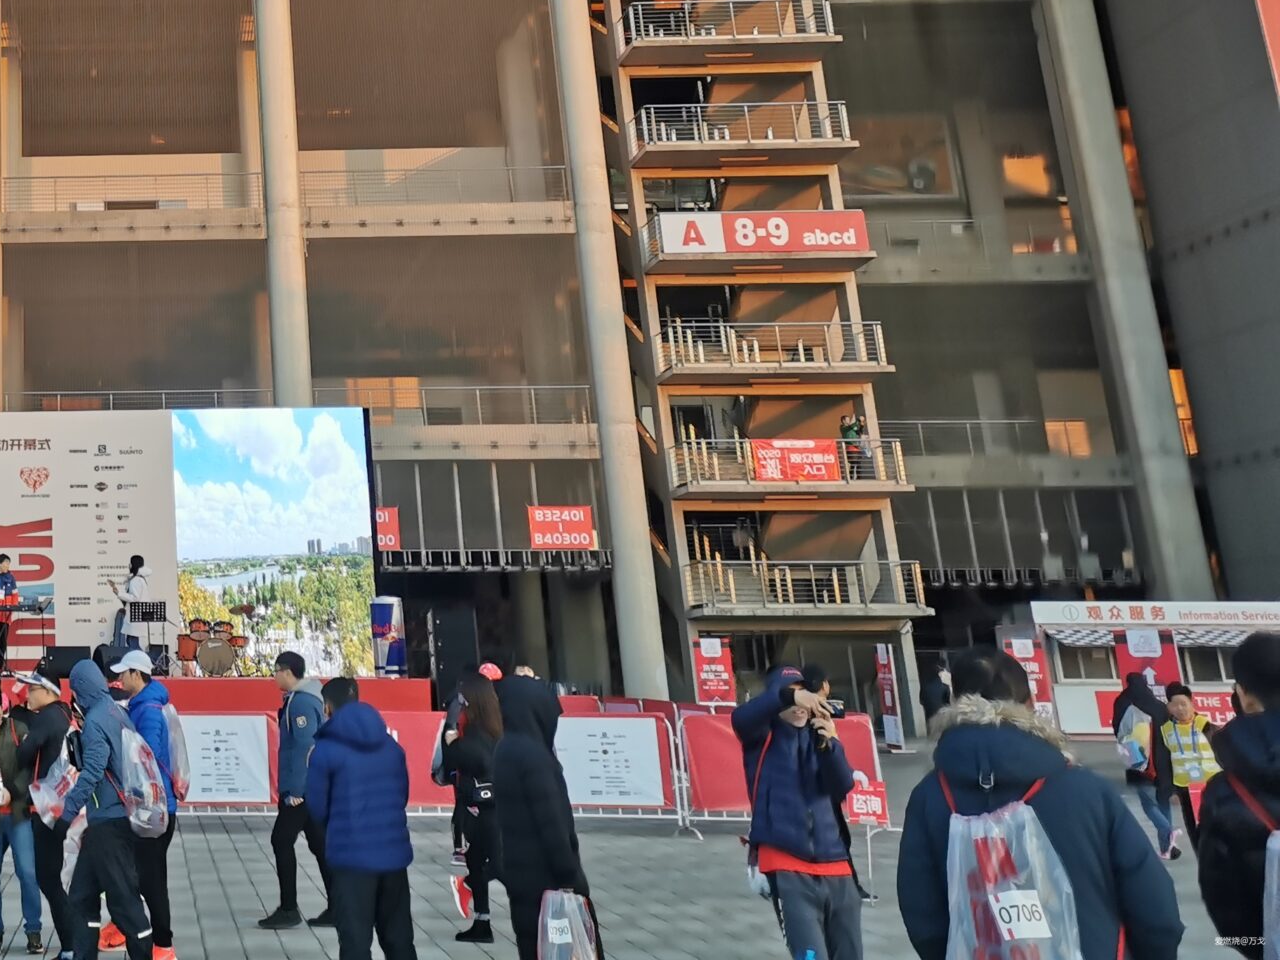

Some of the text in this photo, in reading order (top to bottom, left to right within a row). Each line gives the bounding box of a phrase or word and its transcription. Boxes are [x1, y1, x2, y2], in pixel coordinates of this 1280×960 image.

[682, 217, 856, 246] A 8-9 abcd
[803, 465, 826, 475] 入口
[535, 510, 584, 521] B32401
[534, 533, 590, 544] B40300
[1086, 605, 1166, 621] 观众服务
[1179, 610, 1239, 620] Information
[1194, 696, 1221, 708] THE
[998, 903, 1042, 924] 0706
